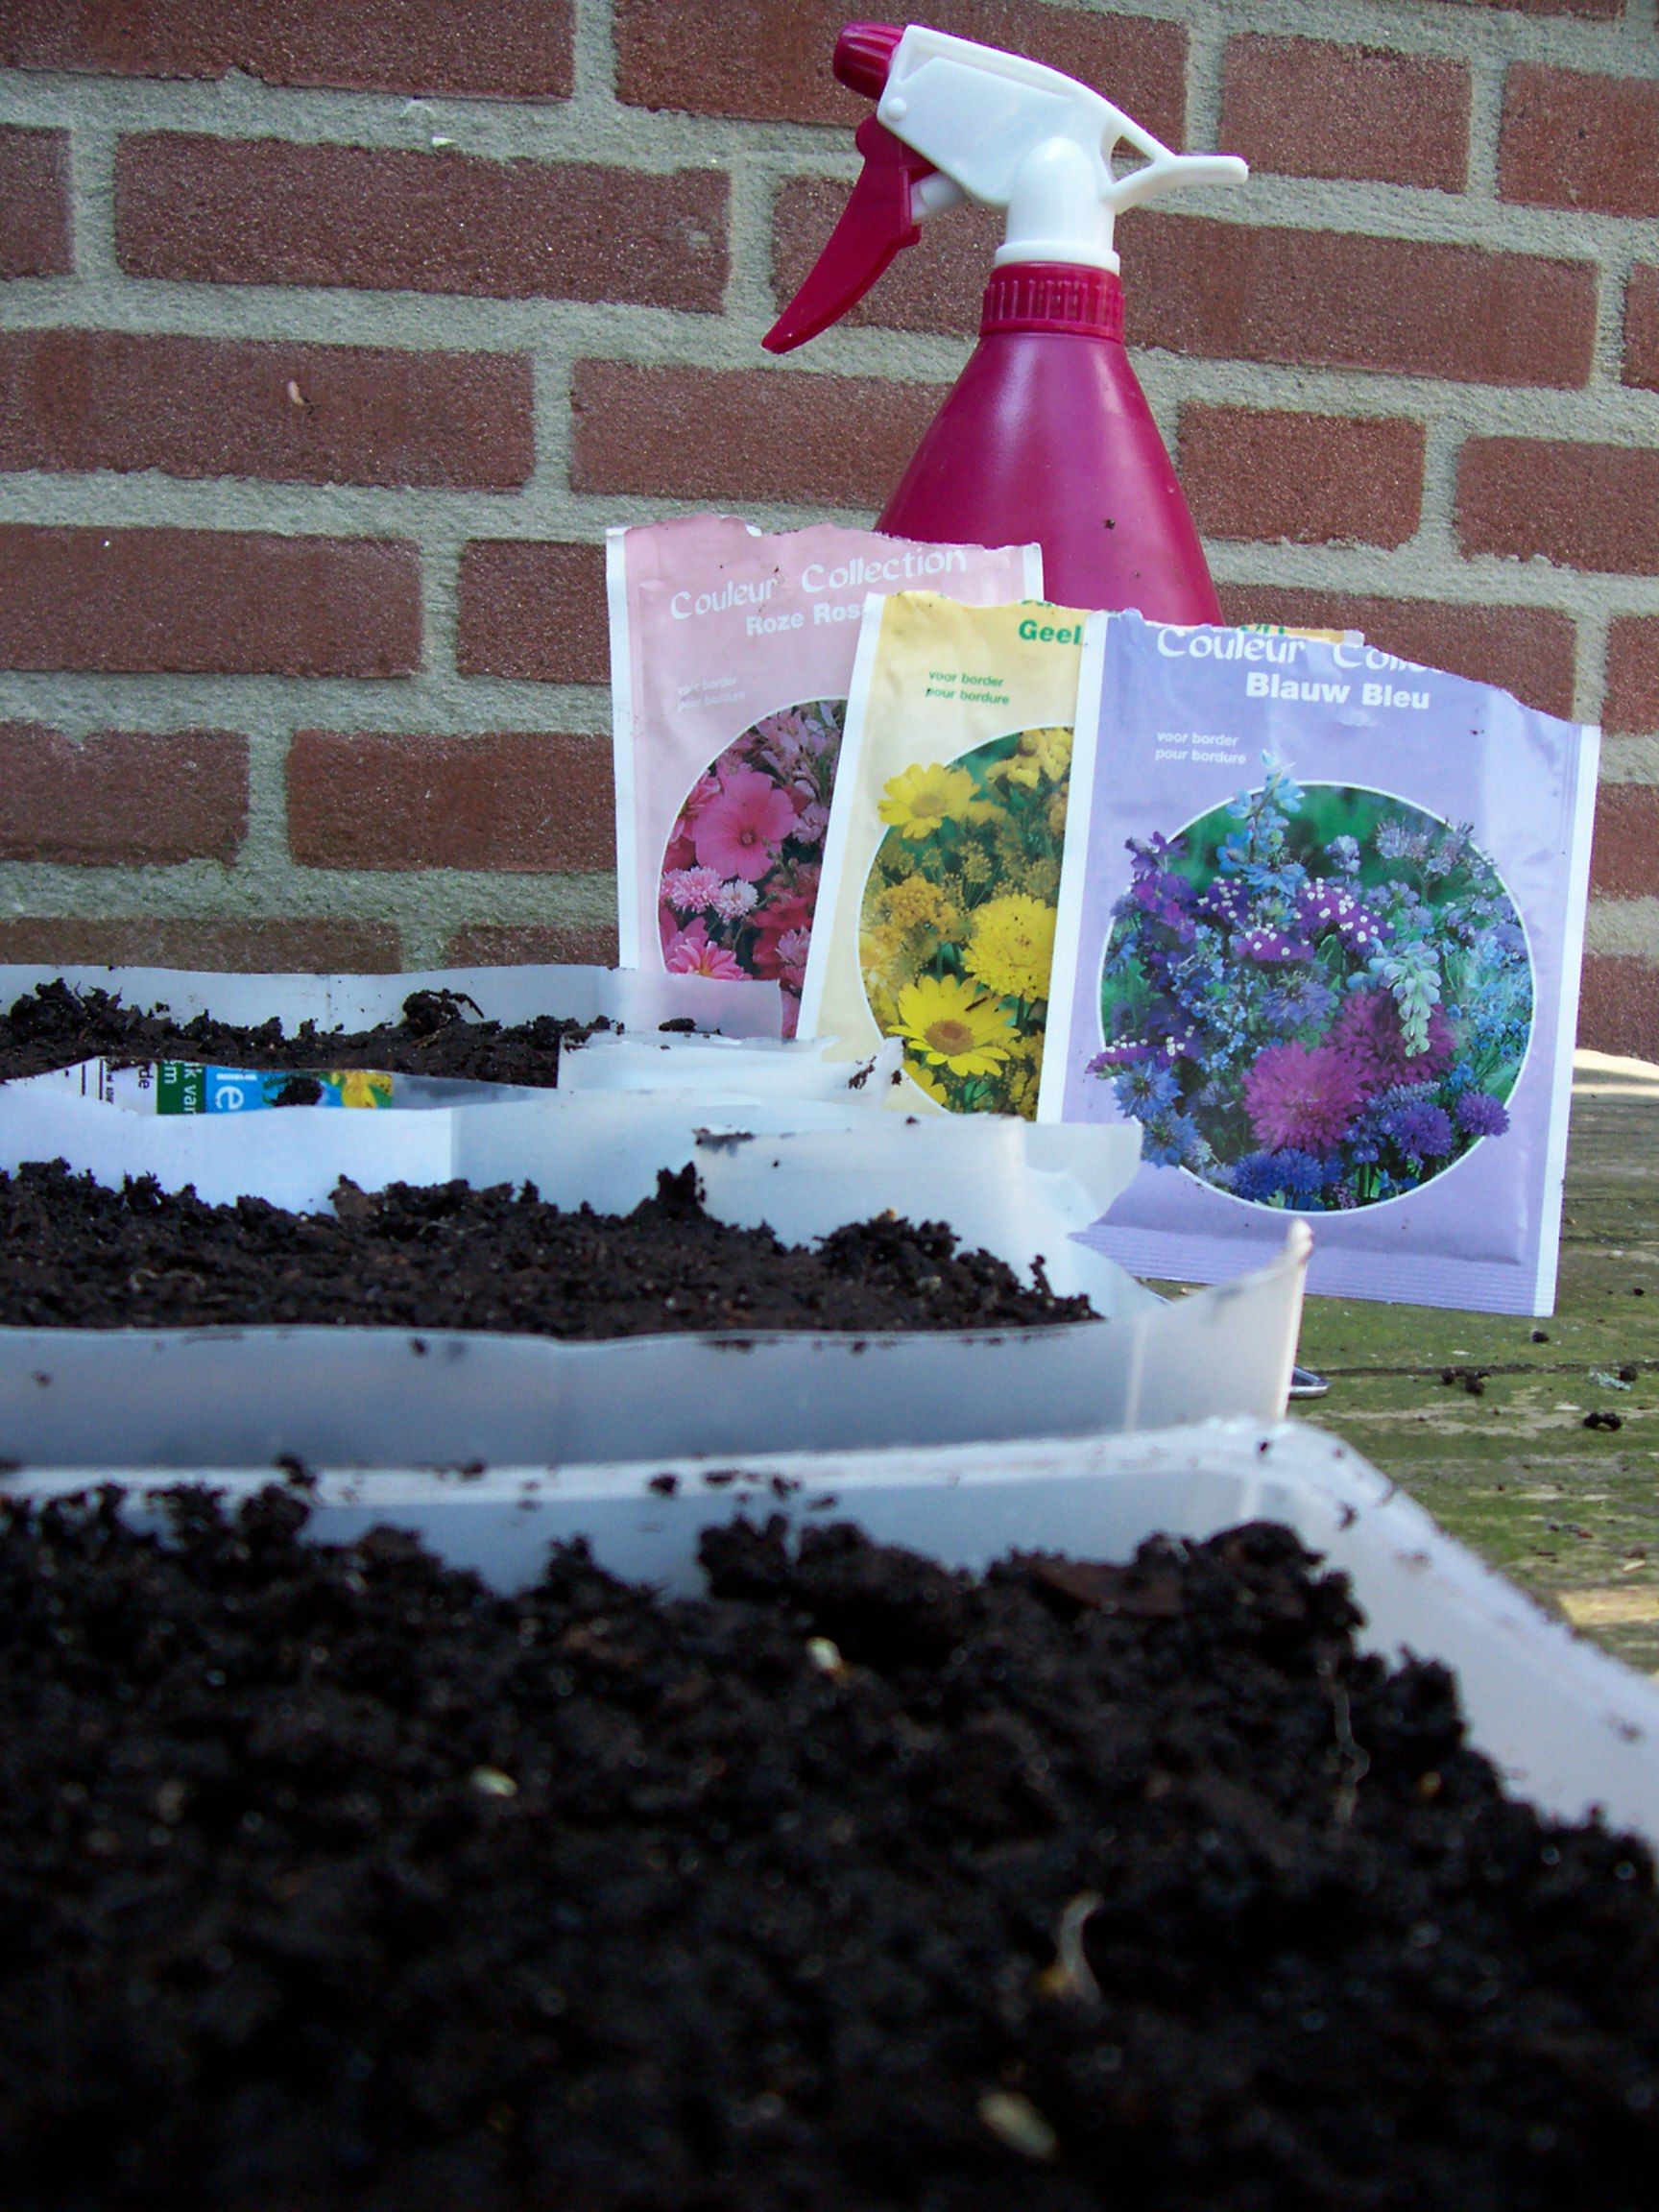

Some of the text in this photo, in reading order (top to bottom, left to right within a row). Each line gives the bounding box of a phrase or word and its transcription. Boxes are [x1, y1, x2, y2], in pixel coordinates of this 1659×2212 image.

[670, 547, 968, 619] Couleur Collection
[746, 603, 865, 637] Roze Ros
[1019, 619, 1082, 645] Geel
[1157, 626, 1306, 663] Couleur
[928, 670, 1004, 686] voor border
[1246, 671, 1431, 709] Blauw Bleu
[926, 686, 1010, 705] pour bordure
[1157, 731, 1239, 747] voor border
[1155, 749, 1246, 764] pour bordure
